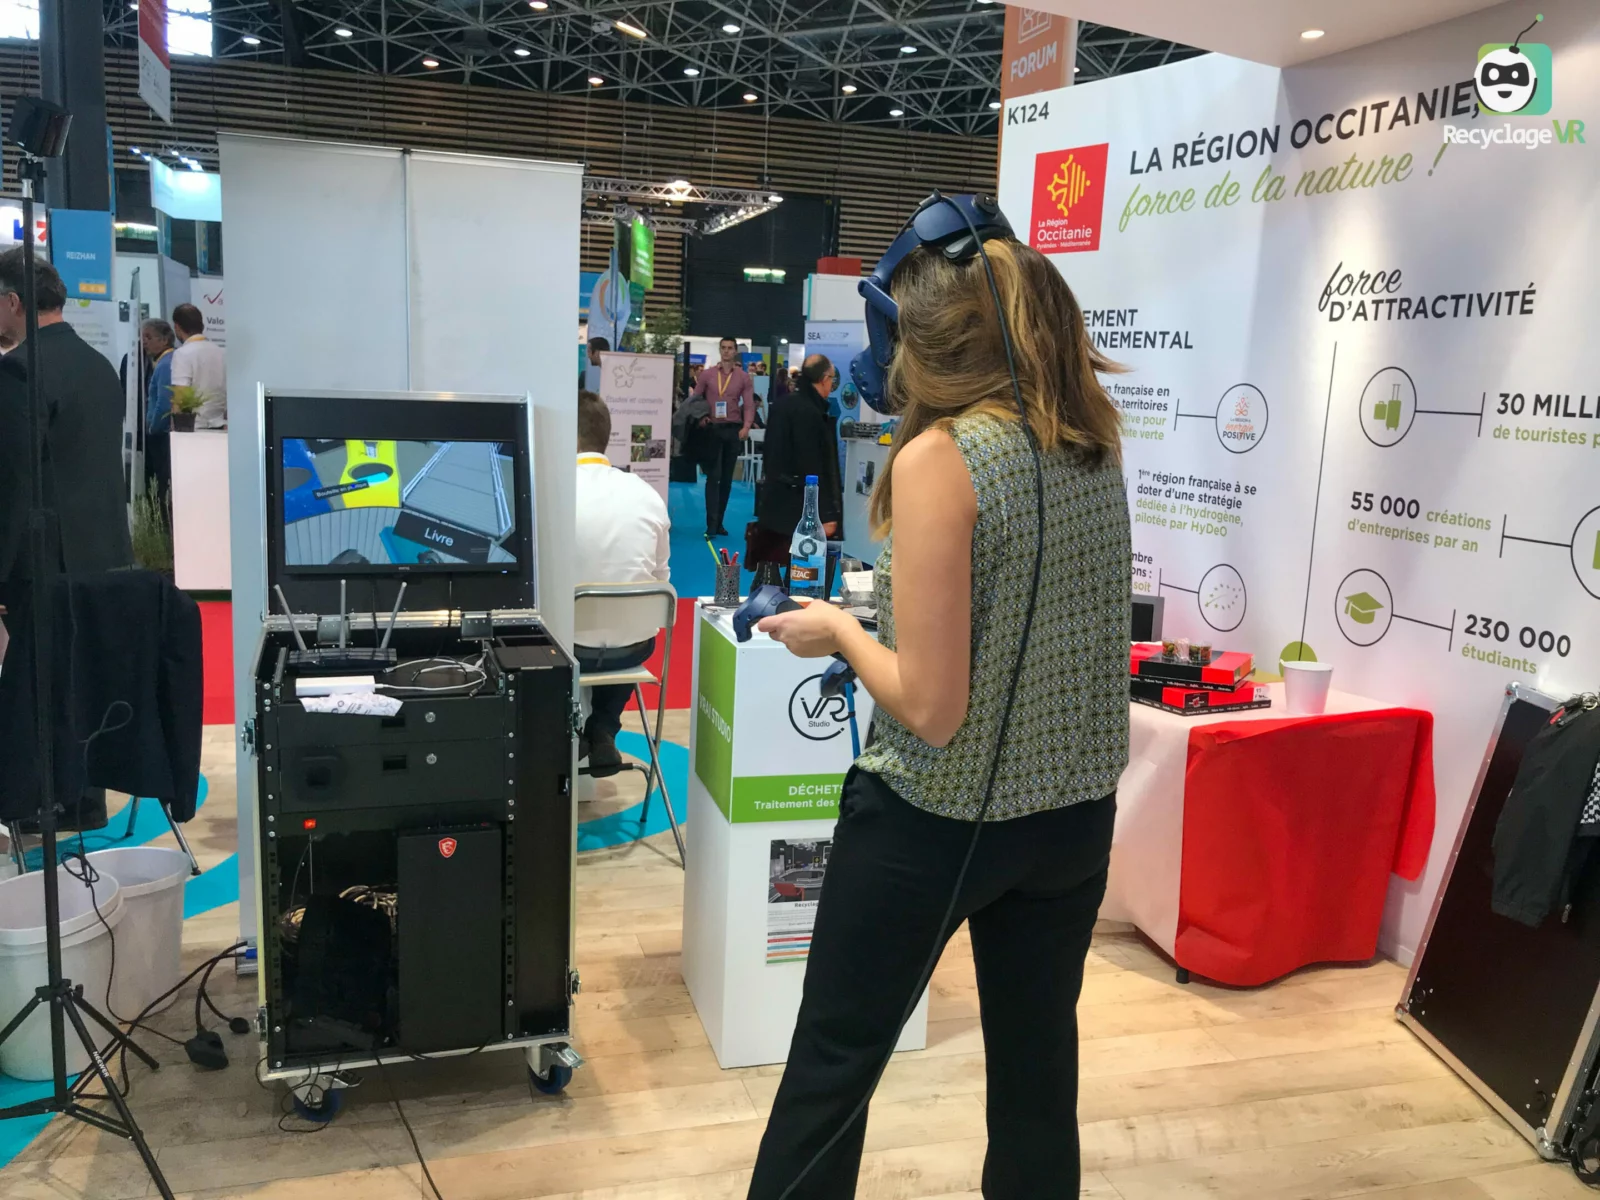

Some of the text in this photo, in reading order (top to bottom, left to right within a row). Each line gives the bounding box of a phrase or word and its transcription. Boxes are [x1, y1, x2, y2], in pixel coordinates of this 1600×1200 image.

[1010, 40, 1058, 82] FORUM
[1007, 101, 1050, 126] K124
[1129, 147, 1163, 175] LA
[1172, 124, 1281, 170] RÉGION
[1118, 182, 1196, 233] force
[1204, 170, 1241, 209] de
[1251, 163, 1286, 202] la
[1294, 151, 1414, 197] nature
[1037, 224, 1093, 242] Occitanie
[1038, 218, 1069, 228] La Région
[66, 251, 96, 261] REIZHAN
[1318, 260, 1403, 313] force
[1113, 383, 1154, 397] française
[1156, 387, 1170, 397] en
[1122, 398, 1169, 412] territoires
[1496, 392, 1525, 416] 30
[1142, 415, 1167, 427] pour
[1140, 429, 1165, 441] verte
[1222, 430, 1256, 441] POSITIVE
[1492, 423, 1511, 440] de
[1515, 425, 1587, 445] touristes
[1152, 471, 1186, 485] région
[1188, 475, 1232, 492] française
[1234, 481, 1241, 494] à
[1244, 484, 1257, 496] se
[1136, 498, 1168, 512] dédiée
[1170, 502, 1176, 514] à
[1137, 483, 1162, 496] doter
[1198, 493, 1243, 510] stratégie
[1135, 513, 1167, 527] pilotée
[1169, 519, 1188, 530] par
[1350, 491, 1492, 531] 55 000 créations
[424, 526, 455, 548] Livre
[1433, 532, 1459, 549] par
[1461, 538, 1479, 553] an
[1133, 581, 1152, 593] soit
[1464, 613, 1572, 658] 230 000
[1461, 642, 1537, 675] étudiants
[808, 720, 831, 728] Studio
[754, 797, 835, 810] Traitement des
